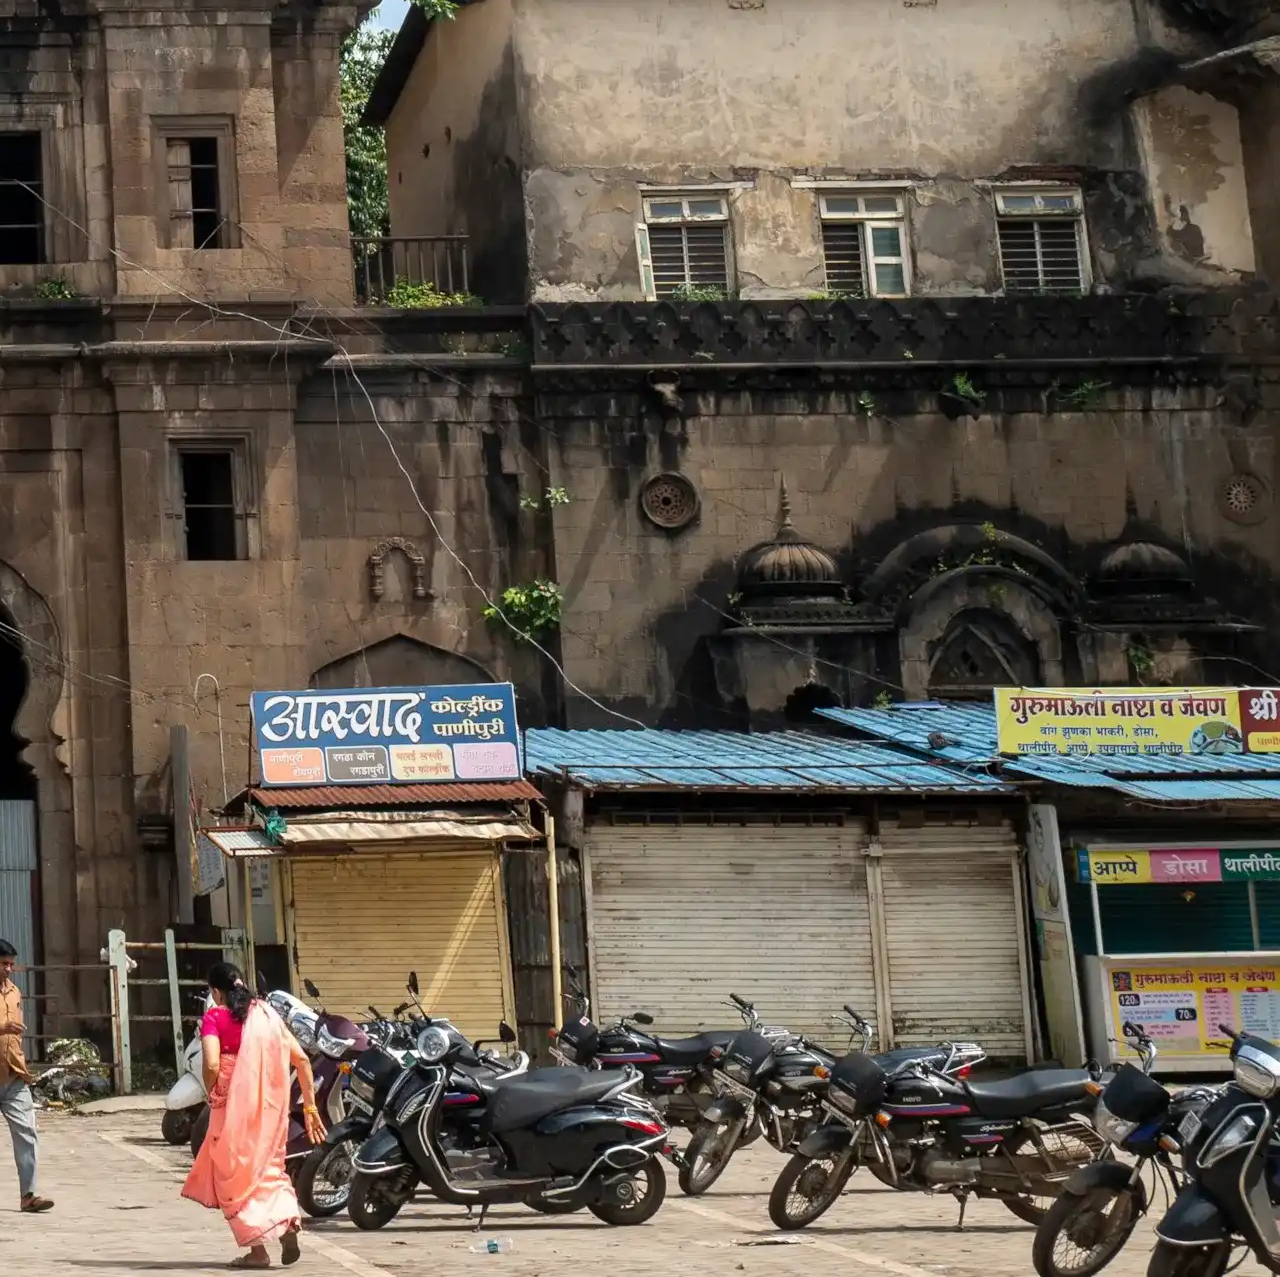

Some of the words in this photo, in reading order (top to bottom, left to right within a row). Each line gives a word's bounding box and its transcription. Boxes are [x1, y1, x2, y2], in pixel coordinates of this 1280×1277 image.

[1160, 697, 1174, 717] व
[1249, 690, 1278, 720] श्री
[261, 692, 425, 743] आस्वाद
[430, 695, 504, 717] कोल्ड्रींक
[432, 718, 505, 740] पाणीपुरी
[1094, 854, 1138, 875] आप्पे
[1162, 854, 1207, 874] डोसा
